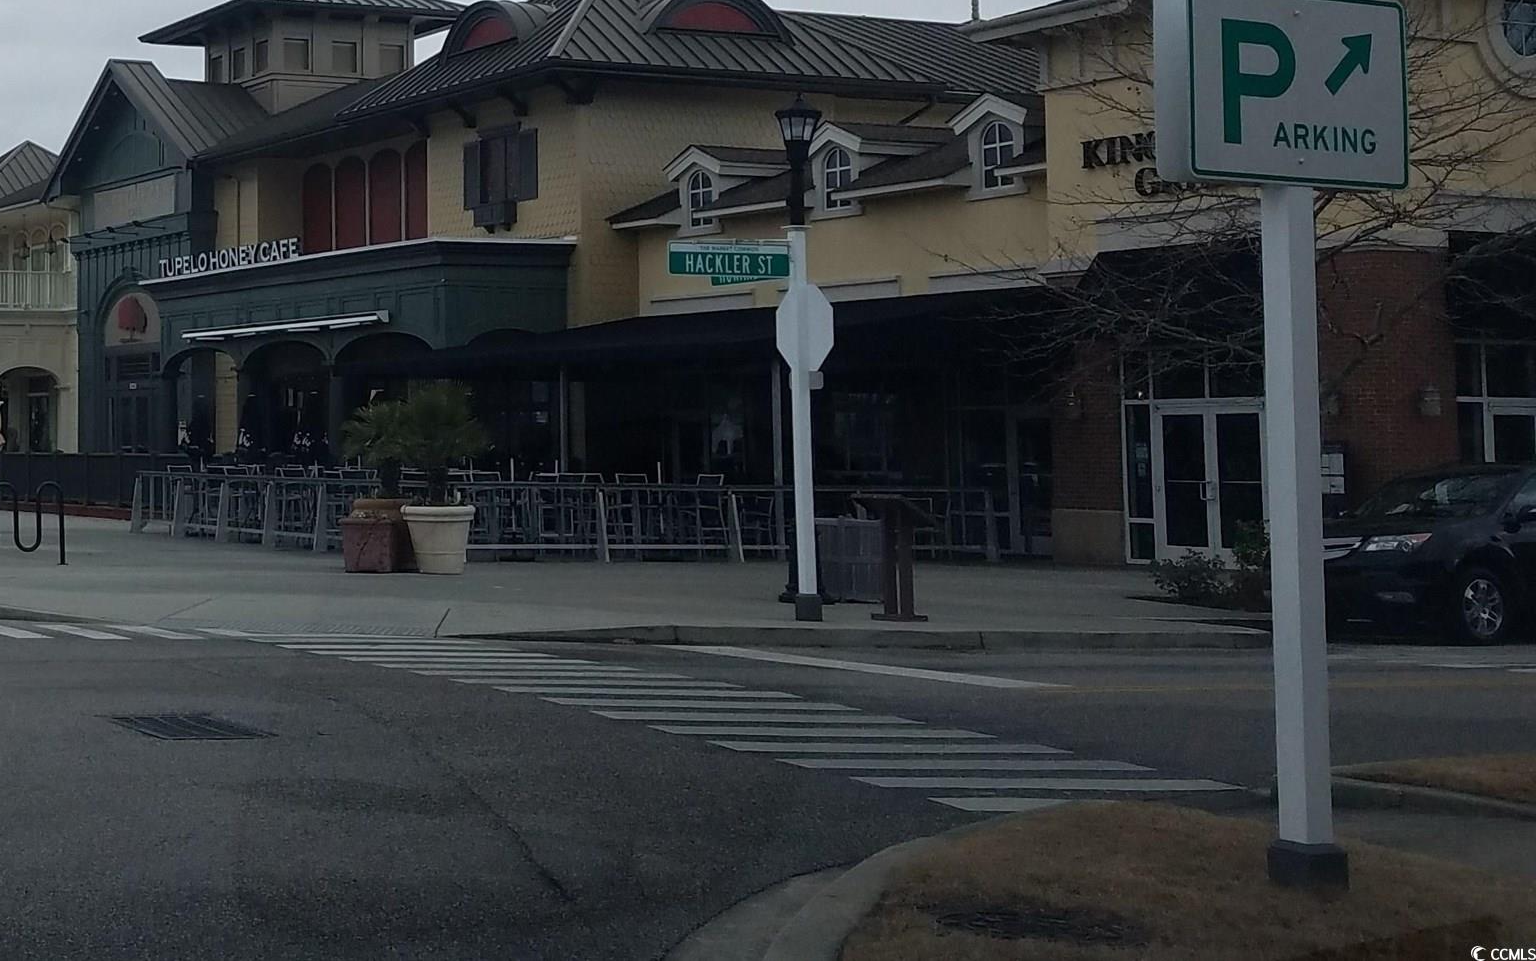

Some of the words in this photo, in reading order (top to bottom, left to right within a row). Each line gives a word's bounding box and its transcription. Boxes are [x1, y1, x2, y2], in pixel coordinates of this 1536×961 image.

[159, 253, 207, 277] TUPELO
[210, 244, 257, 270] HONEY
[260, 238, 299, 262] CAFE
[685, 253, 751, 274] HACKLER
[758, 255, 774, 275] ST
